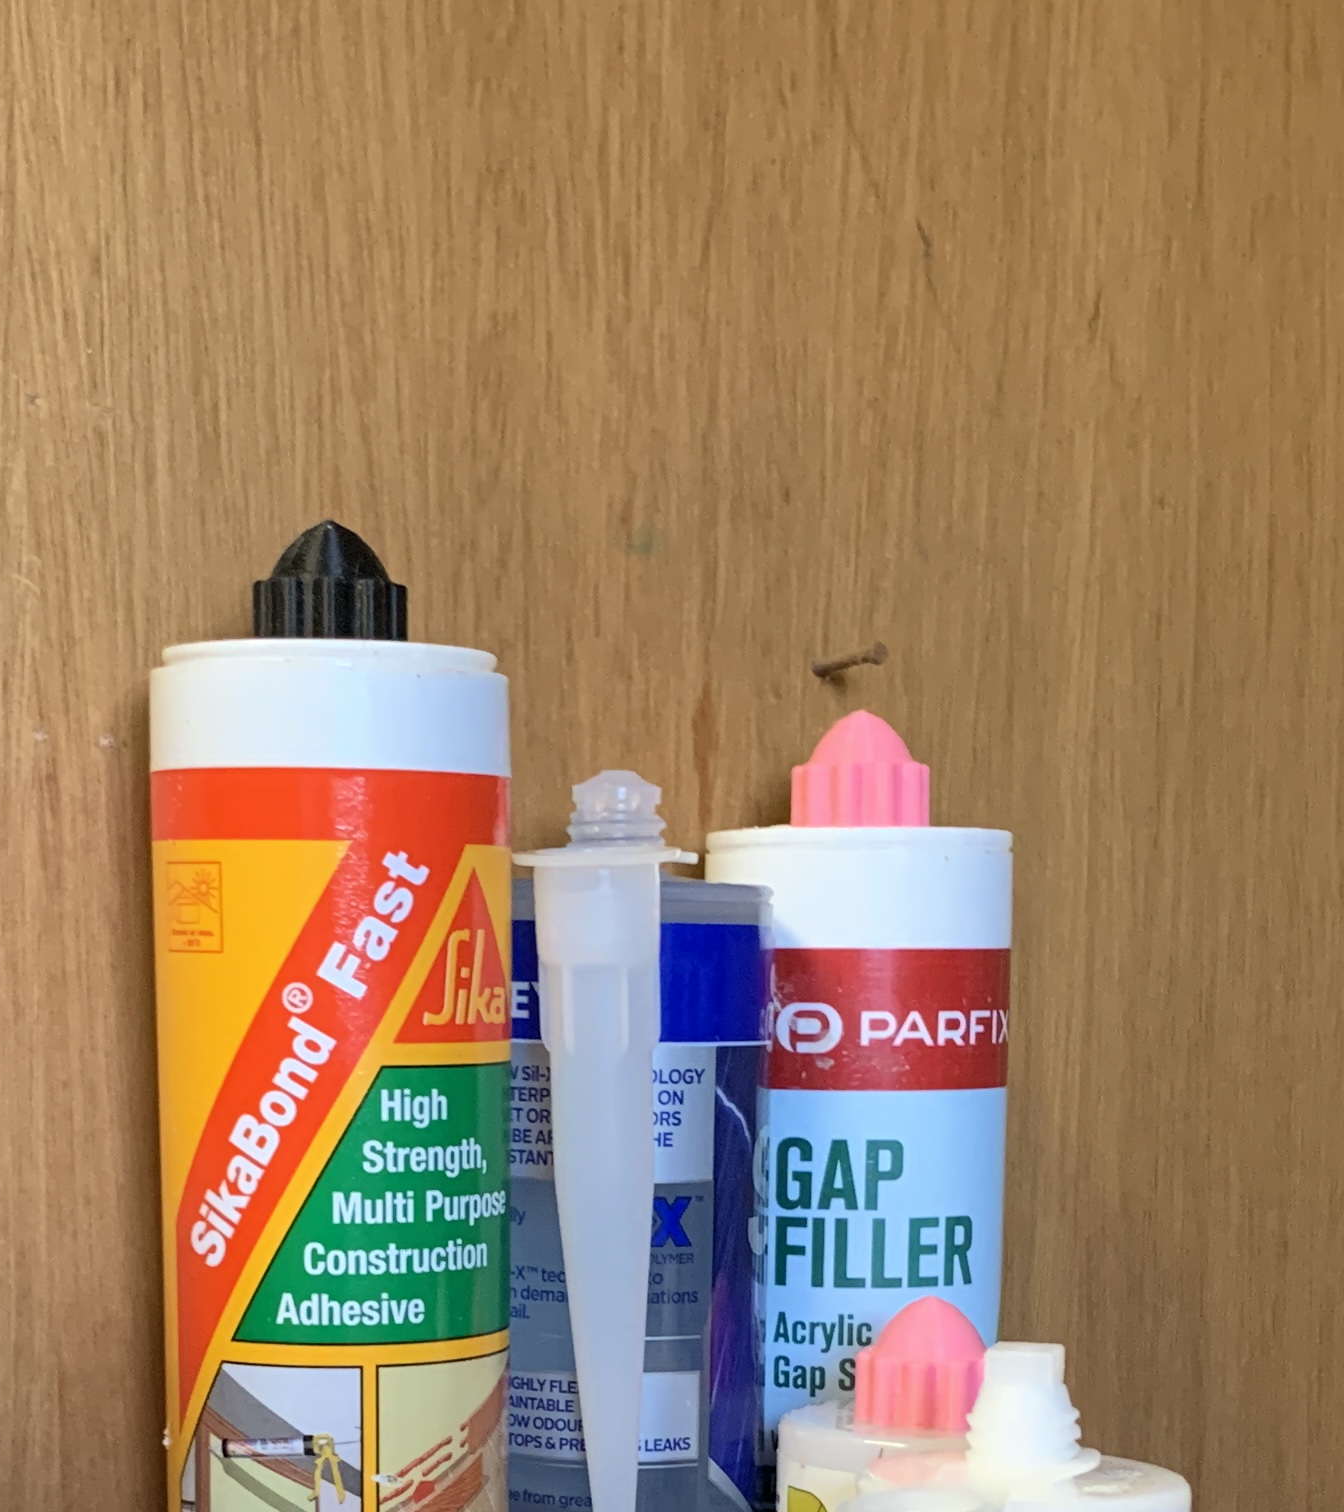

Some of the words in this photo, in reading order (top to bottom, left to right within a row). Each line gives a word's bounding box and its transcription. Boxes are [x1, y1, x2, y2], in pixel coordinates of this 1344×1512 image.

[316, 851, 430, 999] Fast
[422, 929, 506, 1026] Sika
[381, 1088, 448, 1129] High
[658, 1090, 684, 1105] ON
[512, 1128, 532, 1144] BE
[362, 1138, 487, 1179] Strength,
[775, 1137, 904, 1211] GAP
[332, 1191, 414, 1225] Multi
[425, 1190, 506, 1226] Purpose
[304, 1239, 488, 1276] Construction
[774, 1215, 973, 1289] FILLER
[276, 1293, 425, 1326] Adhesive
[773, 1311, 873, 1353] Acrylic
[773, 1355, 825, 1397] Gap
[545, 1436, 556, 1449] &
[645, 1437, 691, 1452] LEAKS
[523, 1489, 555, 1506] from
